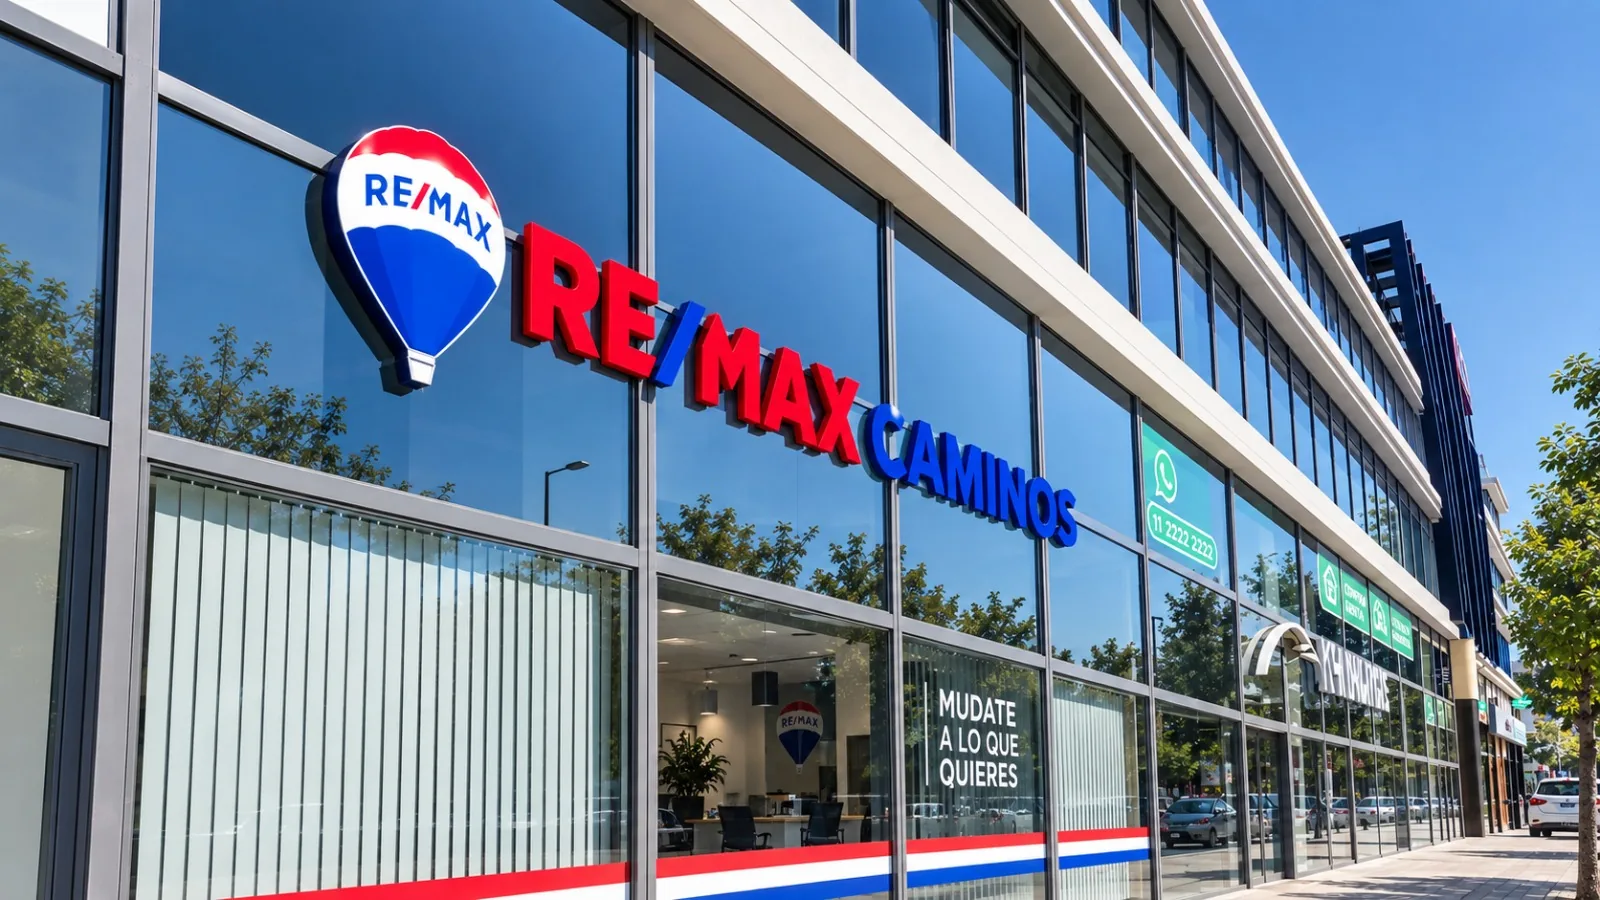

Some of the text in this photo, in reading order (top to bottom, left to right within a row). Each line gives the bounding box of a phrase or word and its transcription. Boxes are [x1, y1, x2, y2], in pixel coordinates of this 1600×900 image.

[365, 173, 492, 253] RE/MAX
[523, 221, 1077, 548] RE/MAX CAMINOS
[1152, 514, 1213, 560] 11 2222 2222
[780, 716, 820, 730] RE/MAX
[939, 688, 1016, 728] MUDATE
[939, 726, 1019, 757] A LO QUE
[939, 758, 1018, 789] QUIERES
